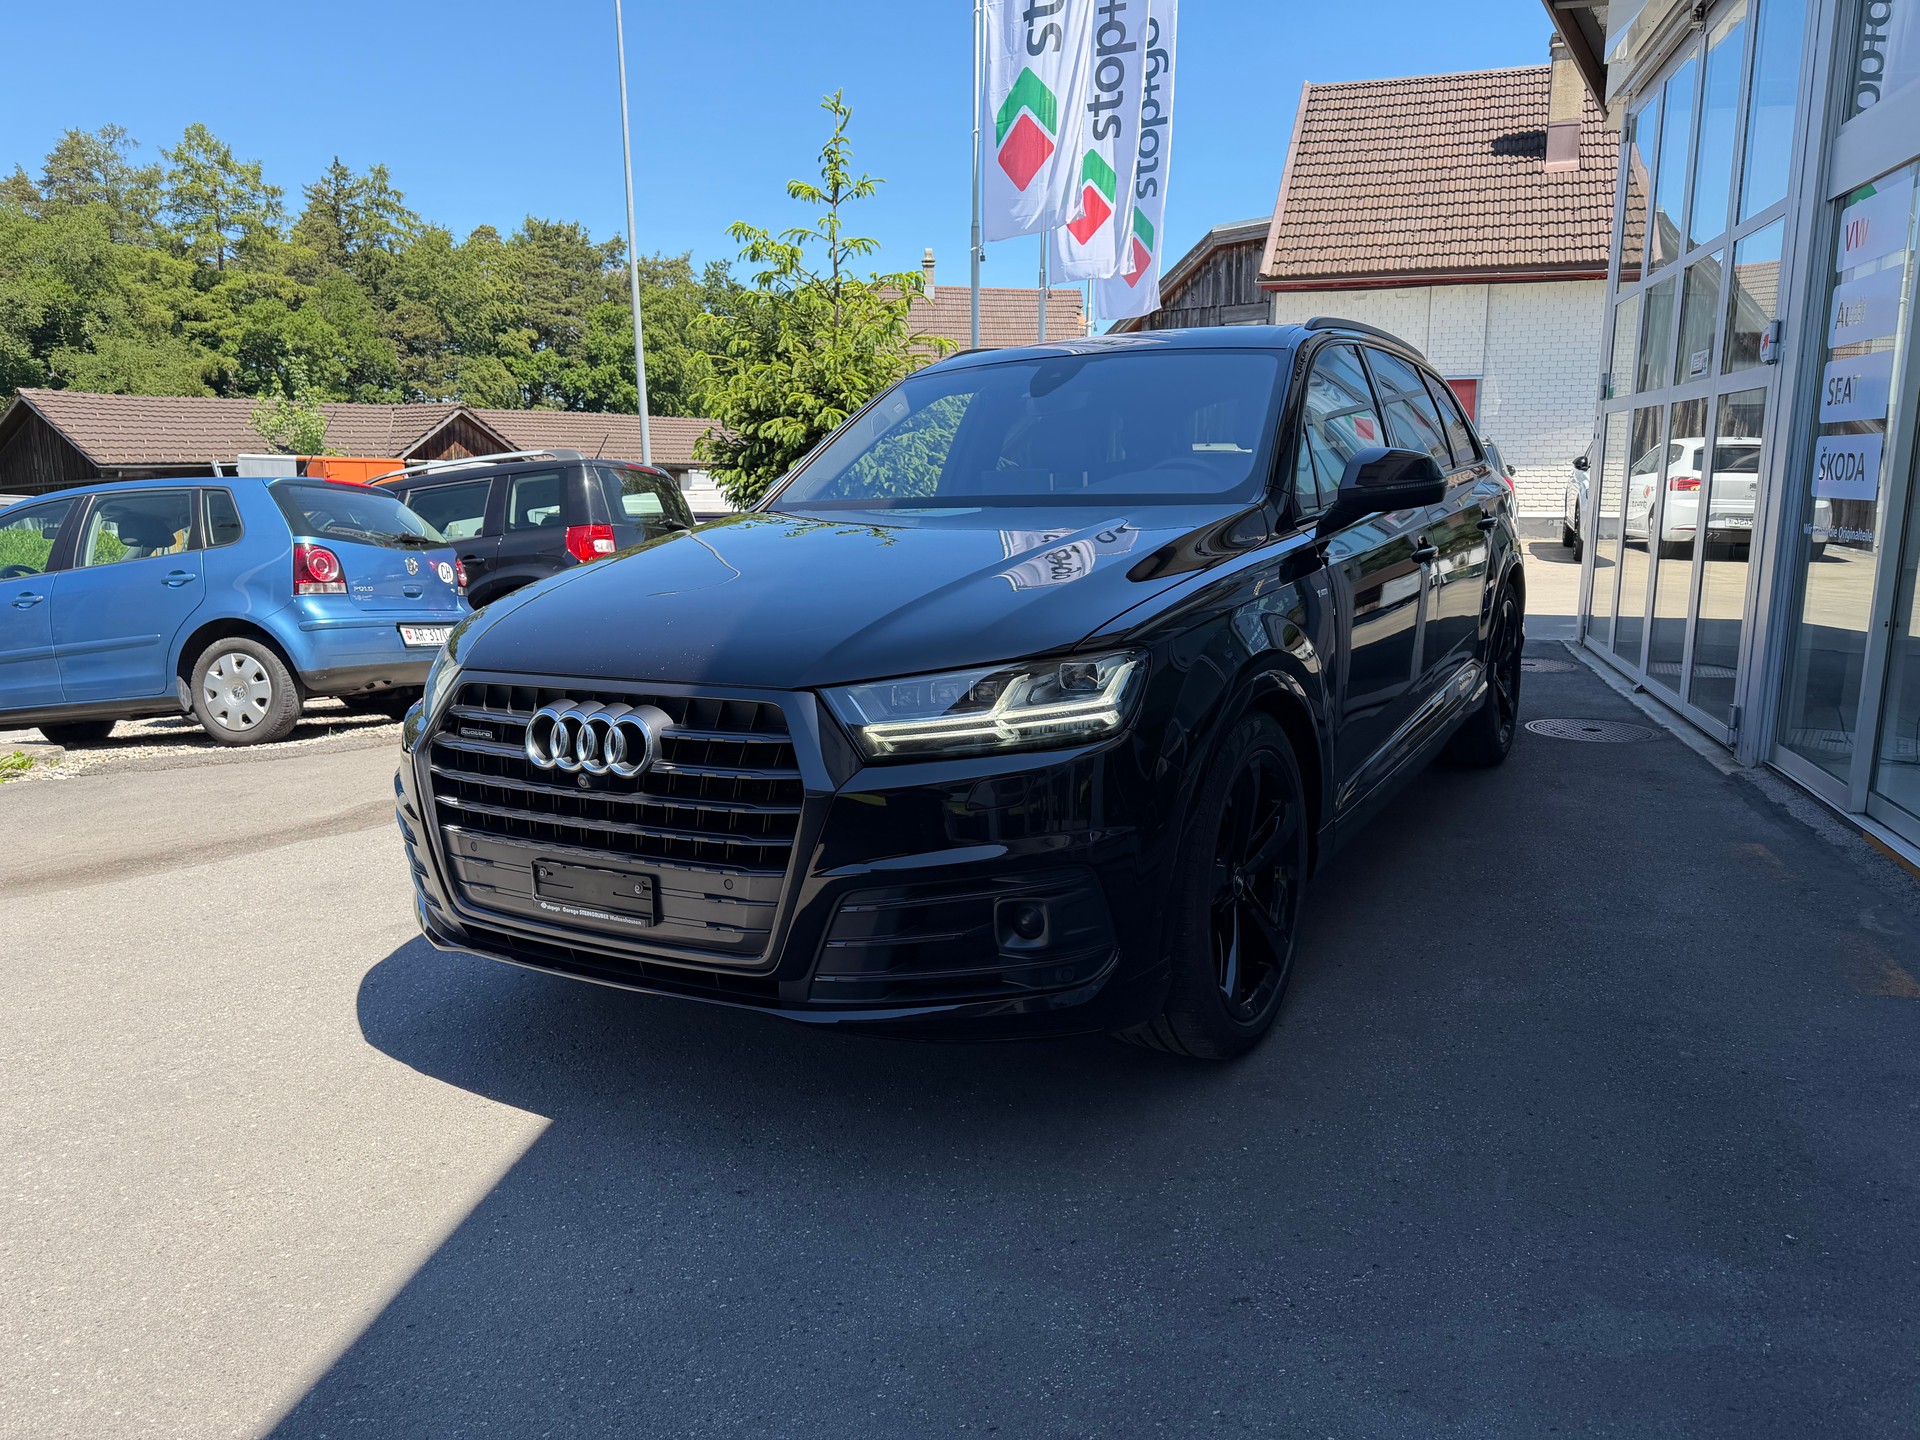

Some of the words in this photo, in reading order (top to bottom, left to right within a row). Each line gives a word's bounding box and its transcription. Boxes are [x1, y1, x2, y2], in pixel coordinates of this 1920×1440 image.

[1846, 217, 1869, 252] VW
[1835, 295, 1866, 330] Audi
[1827, 374, 1861, 406] SEAT
[1819, 446, 1864, 481] ŠKODA
[440, 565, 451, 579] CH
[461, 729, 491, 737] quattro
[562, 906, 579, 916] Garage
